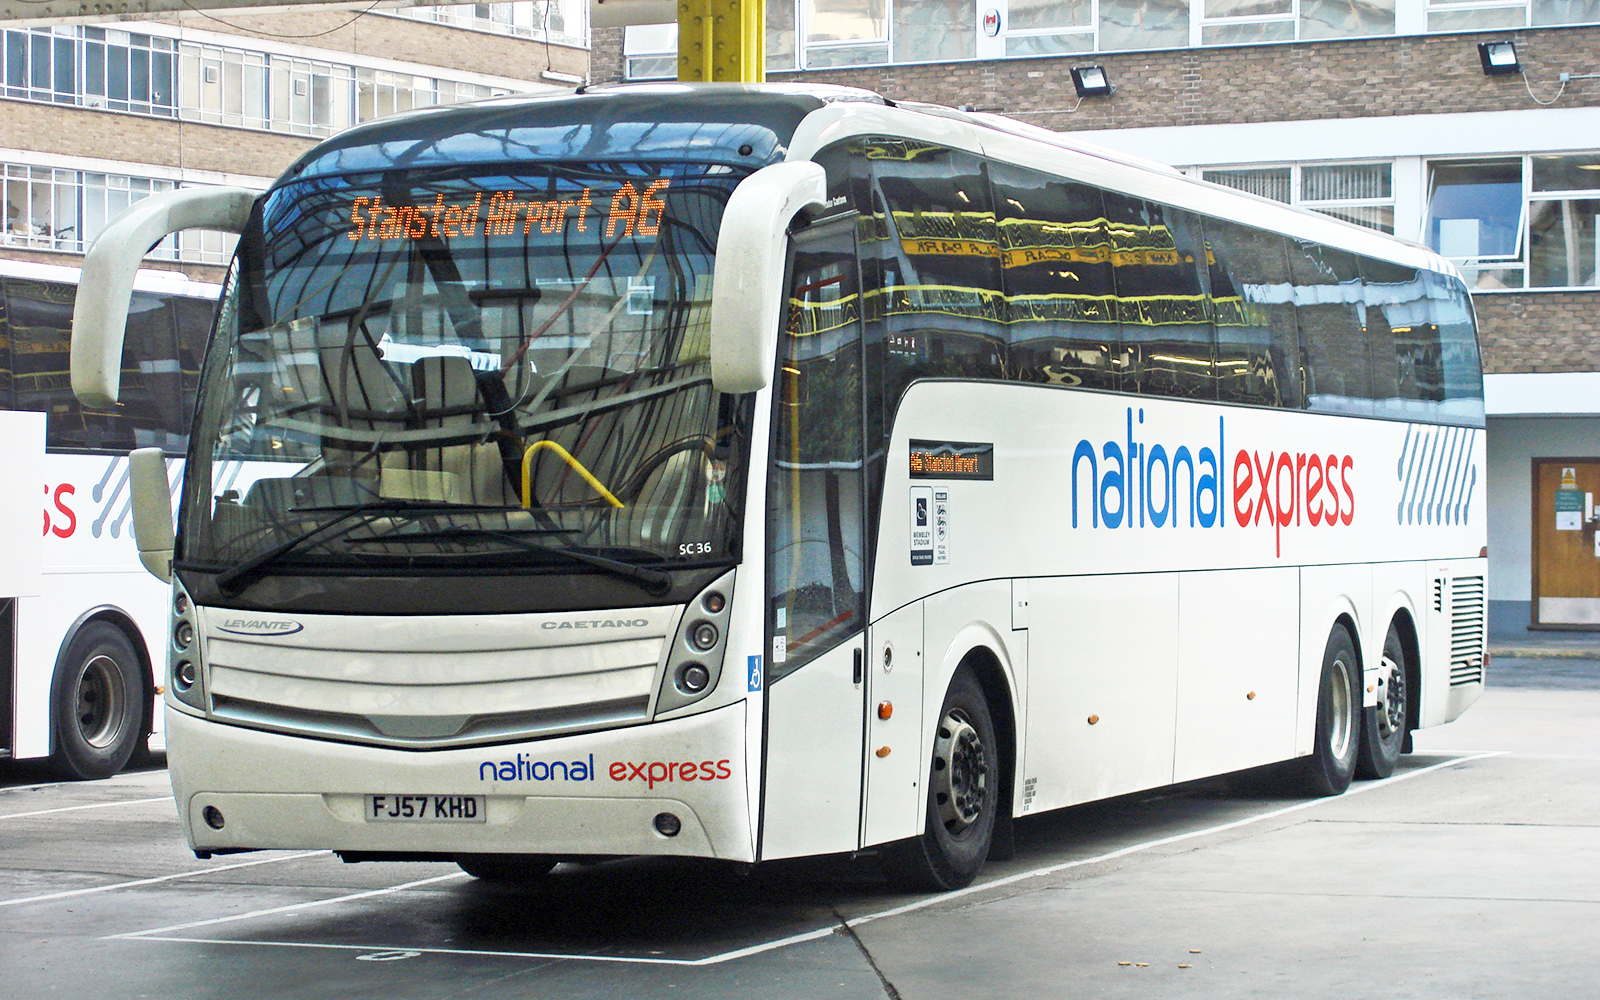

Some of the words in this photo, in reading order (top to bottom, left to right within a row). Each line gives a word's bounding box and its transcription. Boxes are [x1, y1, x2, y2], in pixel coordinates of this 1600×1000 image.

[347, 191, 483, 240] Stansted
[484, 187, 592, 236] Airport
[605, 178, 670, 238] A6
[1071, 406, 1225, 529] national
[1233, 449, 1355, 558] express
[679, 543, 694, 555] SC
[696, 541, 712, 553] 36
[223, 619, 292, 630] LEVANTE
[540, 618, 649, 630] CAETANO
[479, 753, 594, 781] national
[609, 759, 732, 790] express
[372, 796, 428, 818] FJ57
[434, 796, 477, 818] KHD
